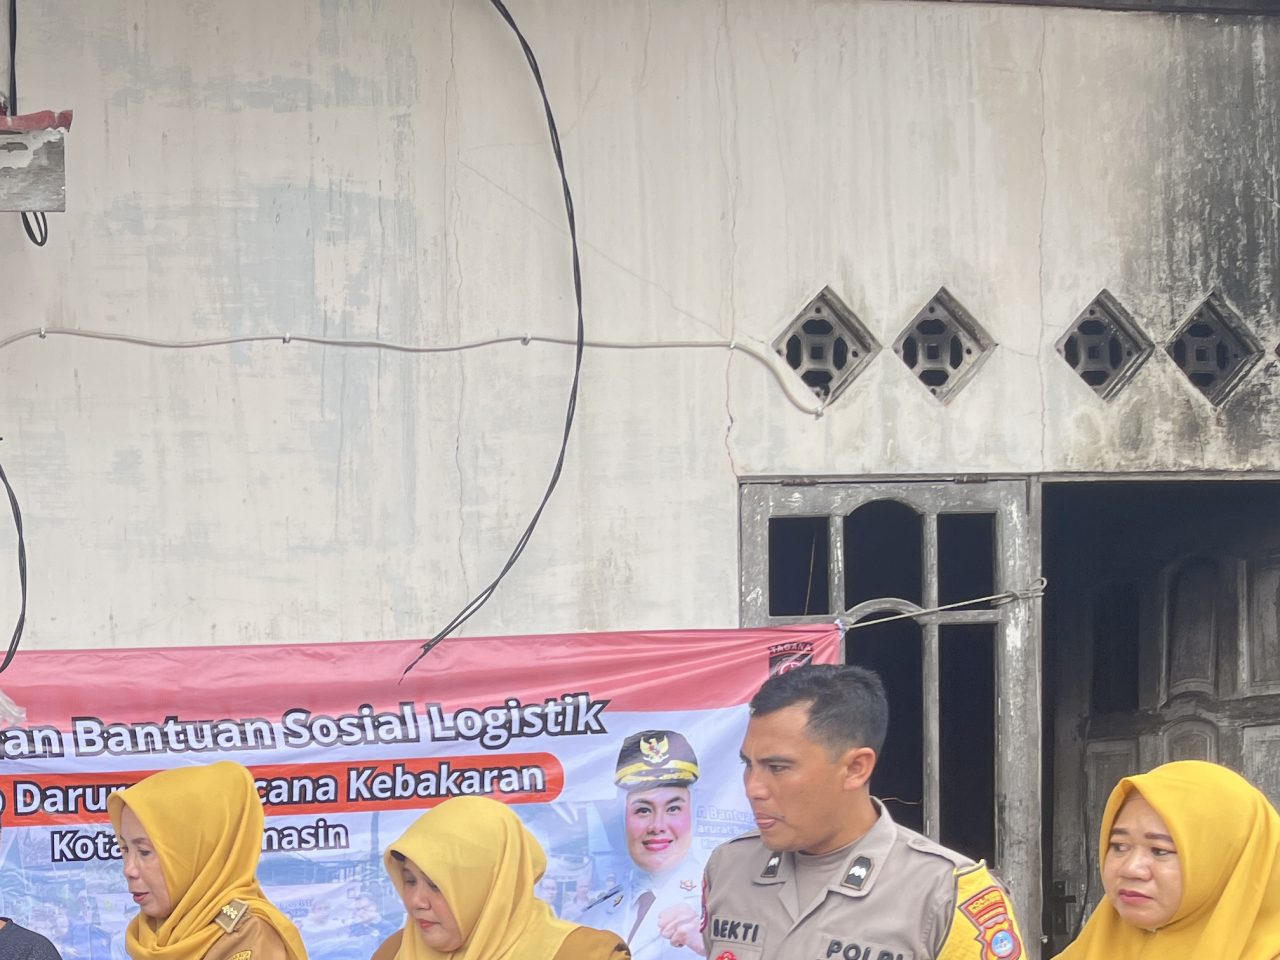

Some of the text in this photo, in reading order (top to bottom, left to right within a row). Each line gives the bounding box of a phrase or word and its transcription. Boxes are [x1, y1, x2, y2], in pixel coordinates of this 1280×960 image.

[72, 716, 275, 755] Bantuan
[283, 703, 420, 747] Sosial
[426, 692, 610, 749] Logistik
[347, 762, 546, 801] Kebakaran
